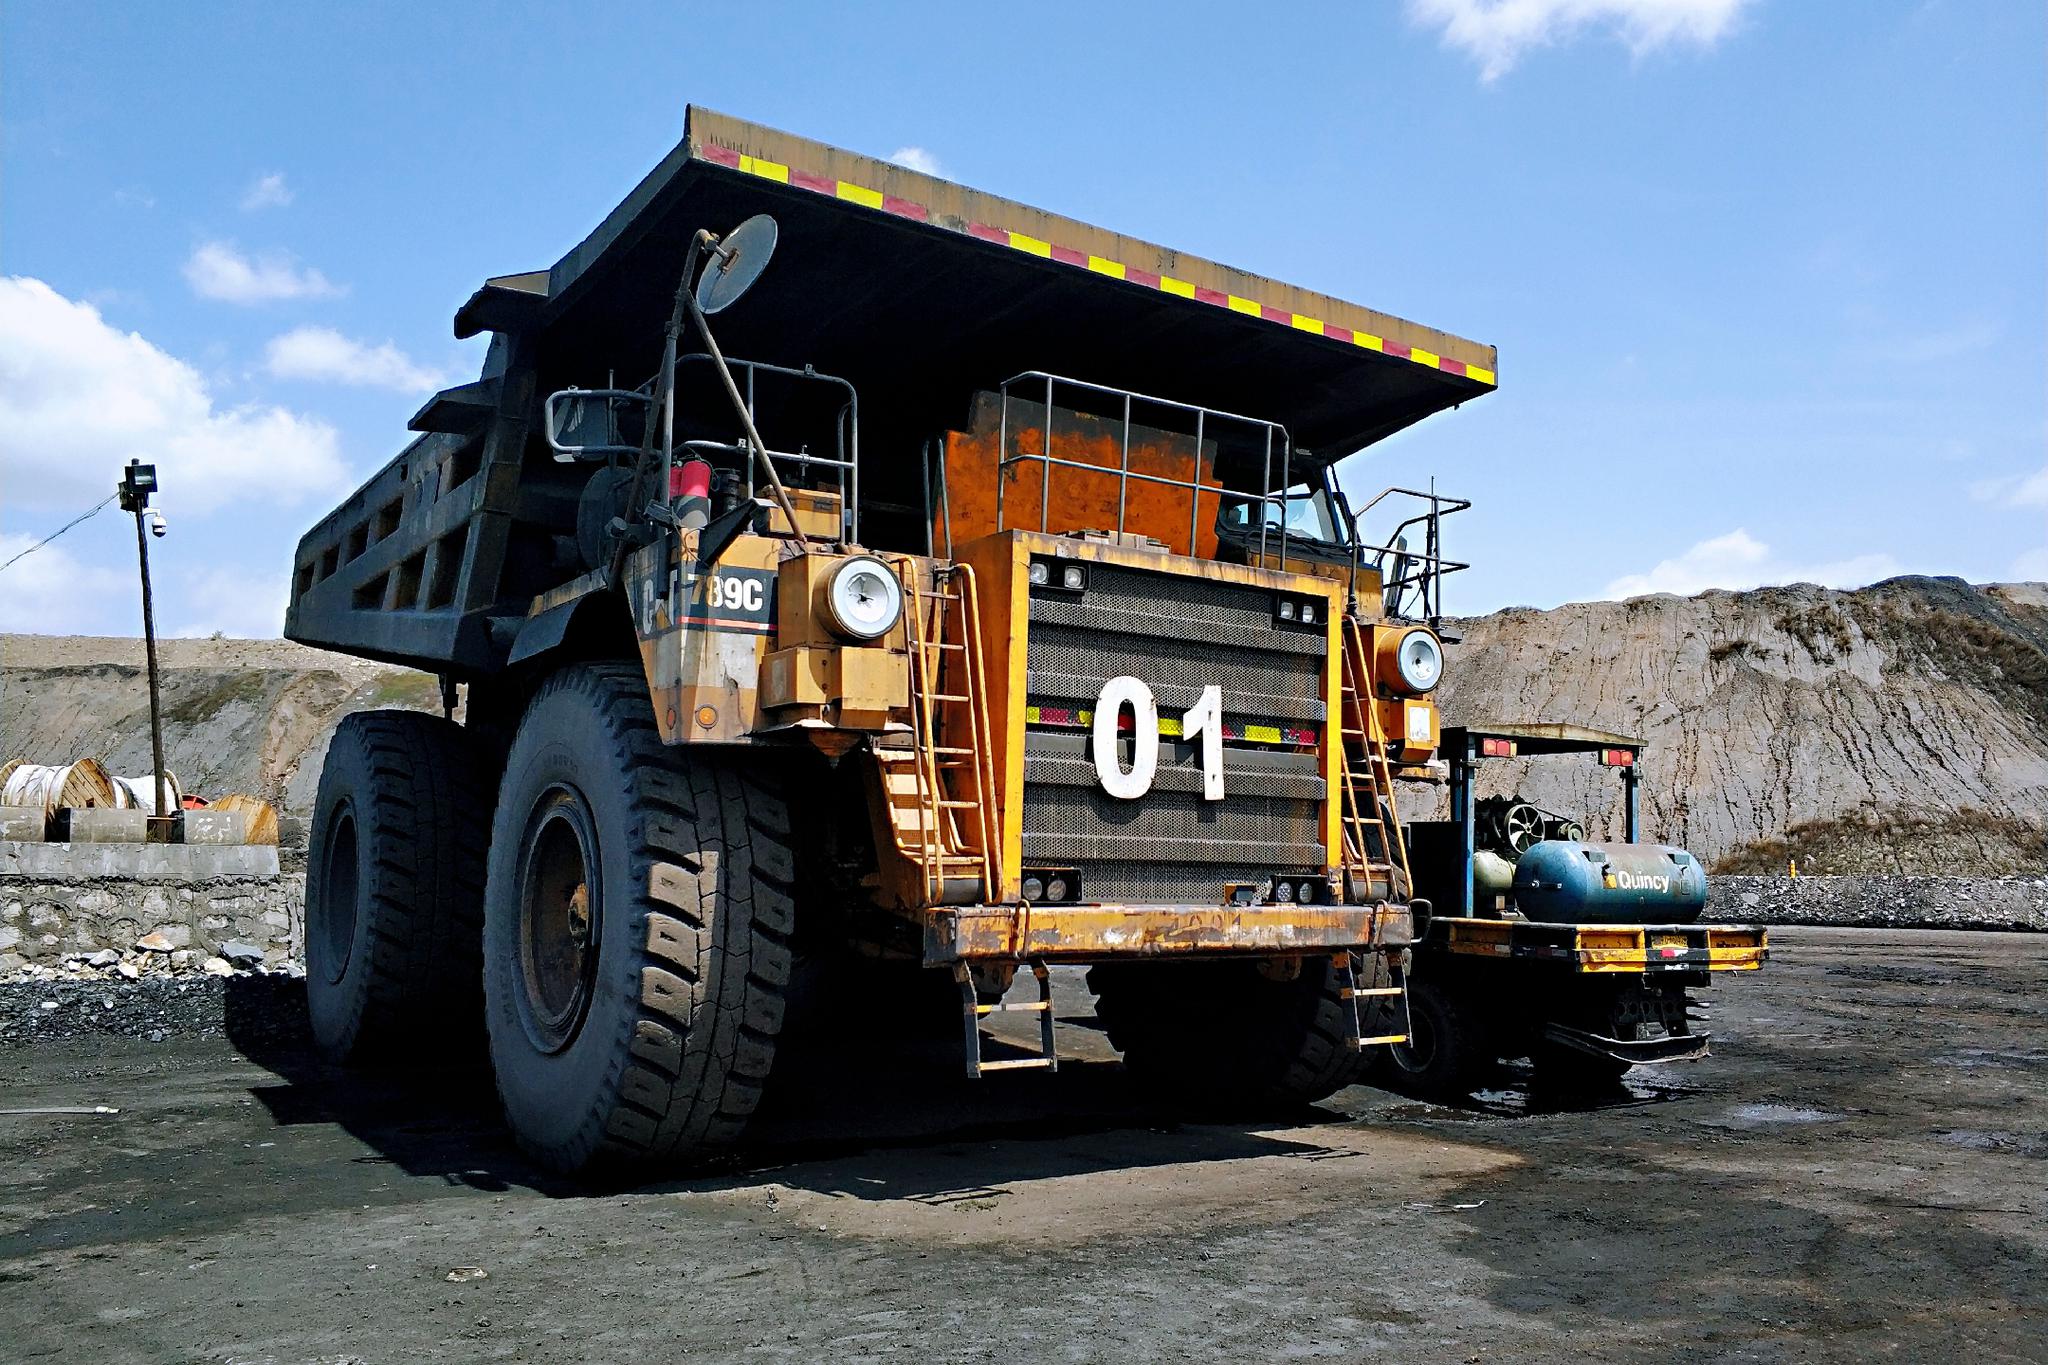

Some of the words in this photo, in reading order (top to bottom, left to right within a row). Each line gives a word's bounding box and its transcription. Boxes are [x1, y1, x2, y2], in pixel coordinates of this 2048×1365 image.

[687, 573, 763, 611] 789C
[1094, 676, 1225, 800] 01
[1618, 870, 1669, 893] Quincy
